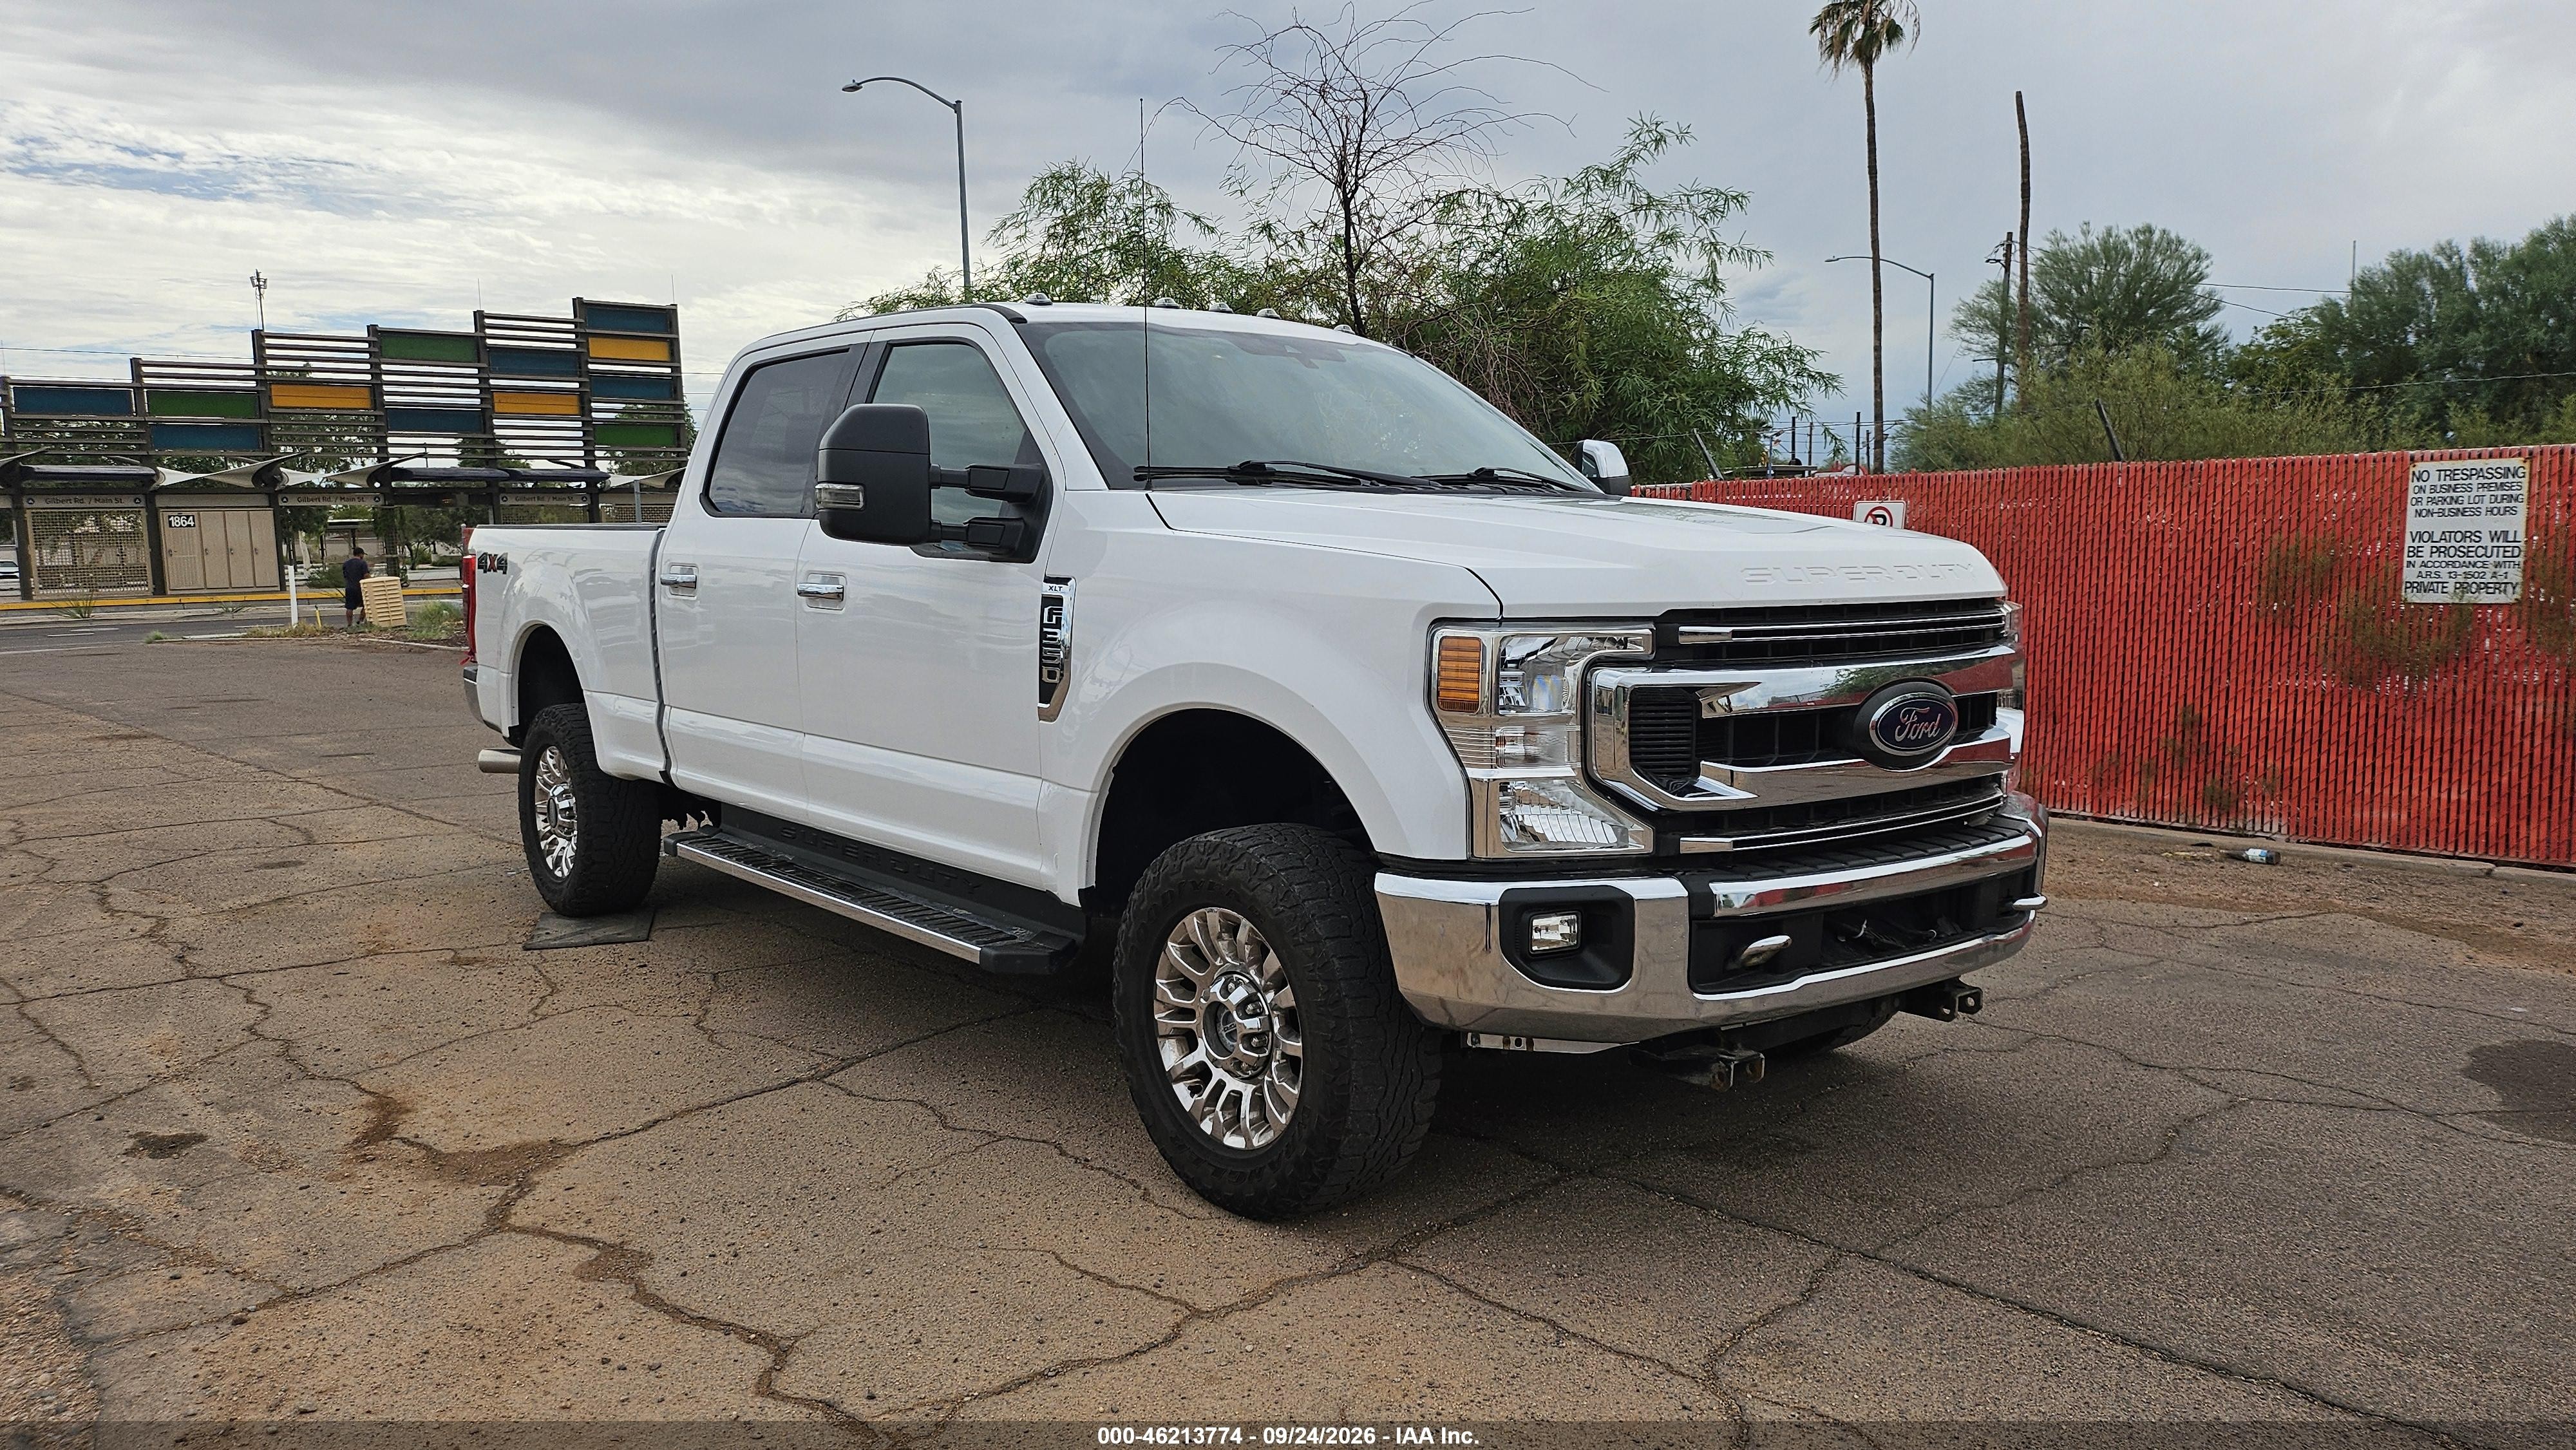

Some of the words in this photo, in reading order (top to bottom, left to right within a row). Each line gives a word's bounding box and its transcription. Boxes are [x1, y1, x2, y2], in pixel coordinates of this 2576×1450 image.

[2411, 469, 2430, 483] NO
[2436, 466, 2526, 482] TRESPASSING
[2413, 485, 2427, 494] ON
[2429, 483, 2473, 494] BUSINESS
[2477, 482, 2523, 492] PREMISES
[2410, 497, 2423, 506] OR
[2427, 495, 2465, 505] PARKING
[2468, 495, 2486, 504] LOT
[2489, 494, 2524, 504] DURING
[2414, 507, 2482, 518] NON-BUSINESS
[2485, 506, 2517, 516] HOURS
[169, 516, 195, 527] 1864
[2410, 531, 2482, 543] VIOLATORS
[2488, 531, 2521, 543] WILL
[2407, 546, 2424, 558] BE
[2430, 545, 2521, 558] PROSECUTED
[1741, 565, 1894, 585] SUPER
[1894, 563, 1976, 581] DUTY
[2448, 571, 2486, 579] 13-1502
[2404, 581, 2448, 594] PRIVATE
[2454, 581, 2519, 594] PROPERTY
[1895, 706, 1942, 742] Ford
